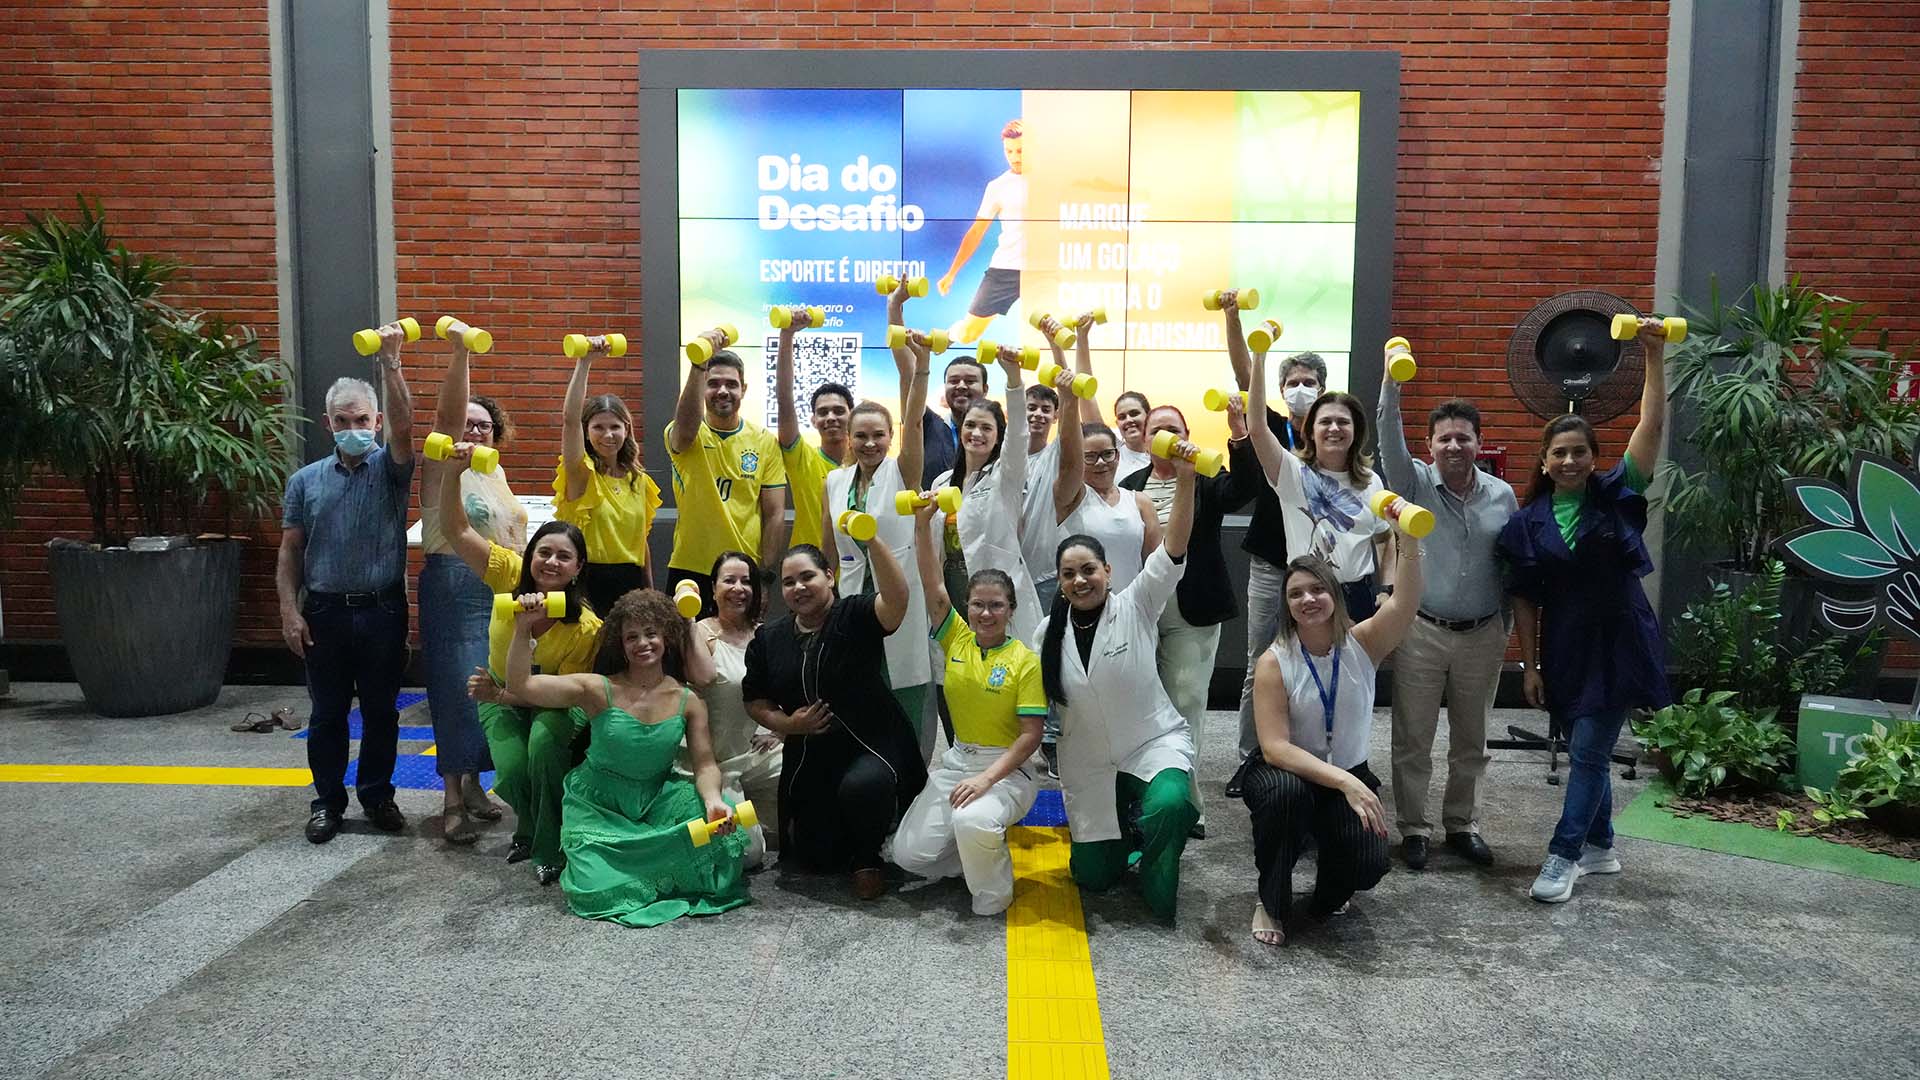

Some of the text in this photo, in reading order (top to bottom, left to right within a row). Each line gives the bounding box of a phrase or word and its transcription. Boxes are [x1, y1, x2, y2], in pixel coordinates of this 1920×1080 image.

[758, 154, 897, 192] Dia do
[758, 194, 925, 232] Desafio
[1058, 203, 1149, 231] MARQUE
[760, 260, 835, 284] ESPORTE
[839, 256, 850, 284] É
[1058, 242, 1092, 271] UM
[845, 304, 854, 313] o
[1147, 282, 1162, 311] O
